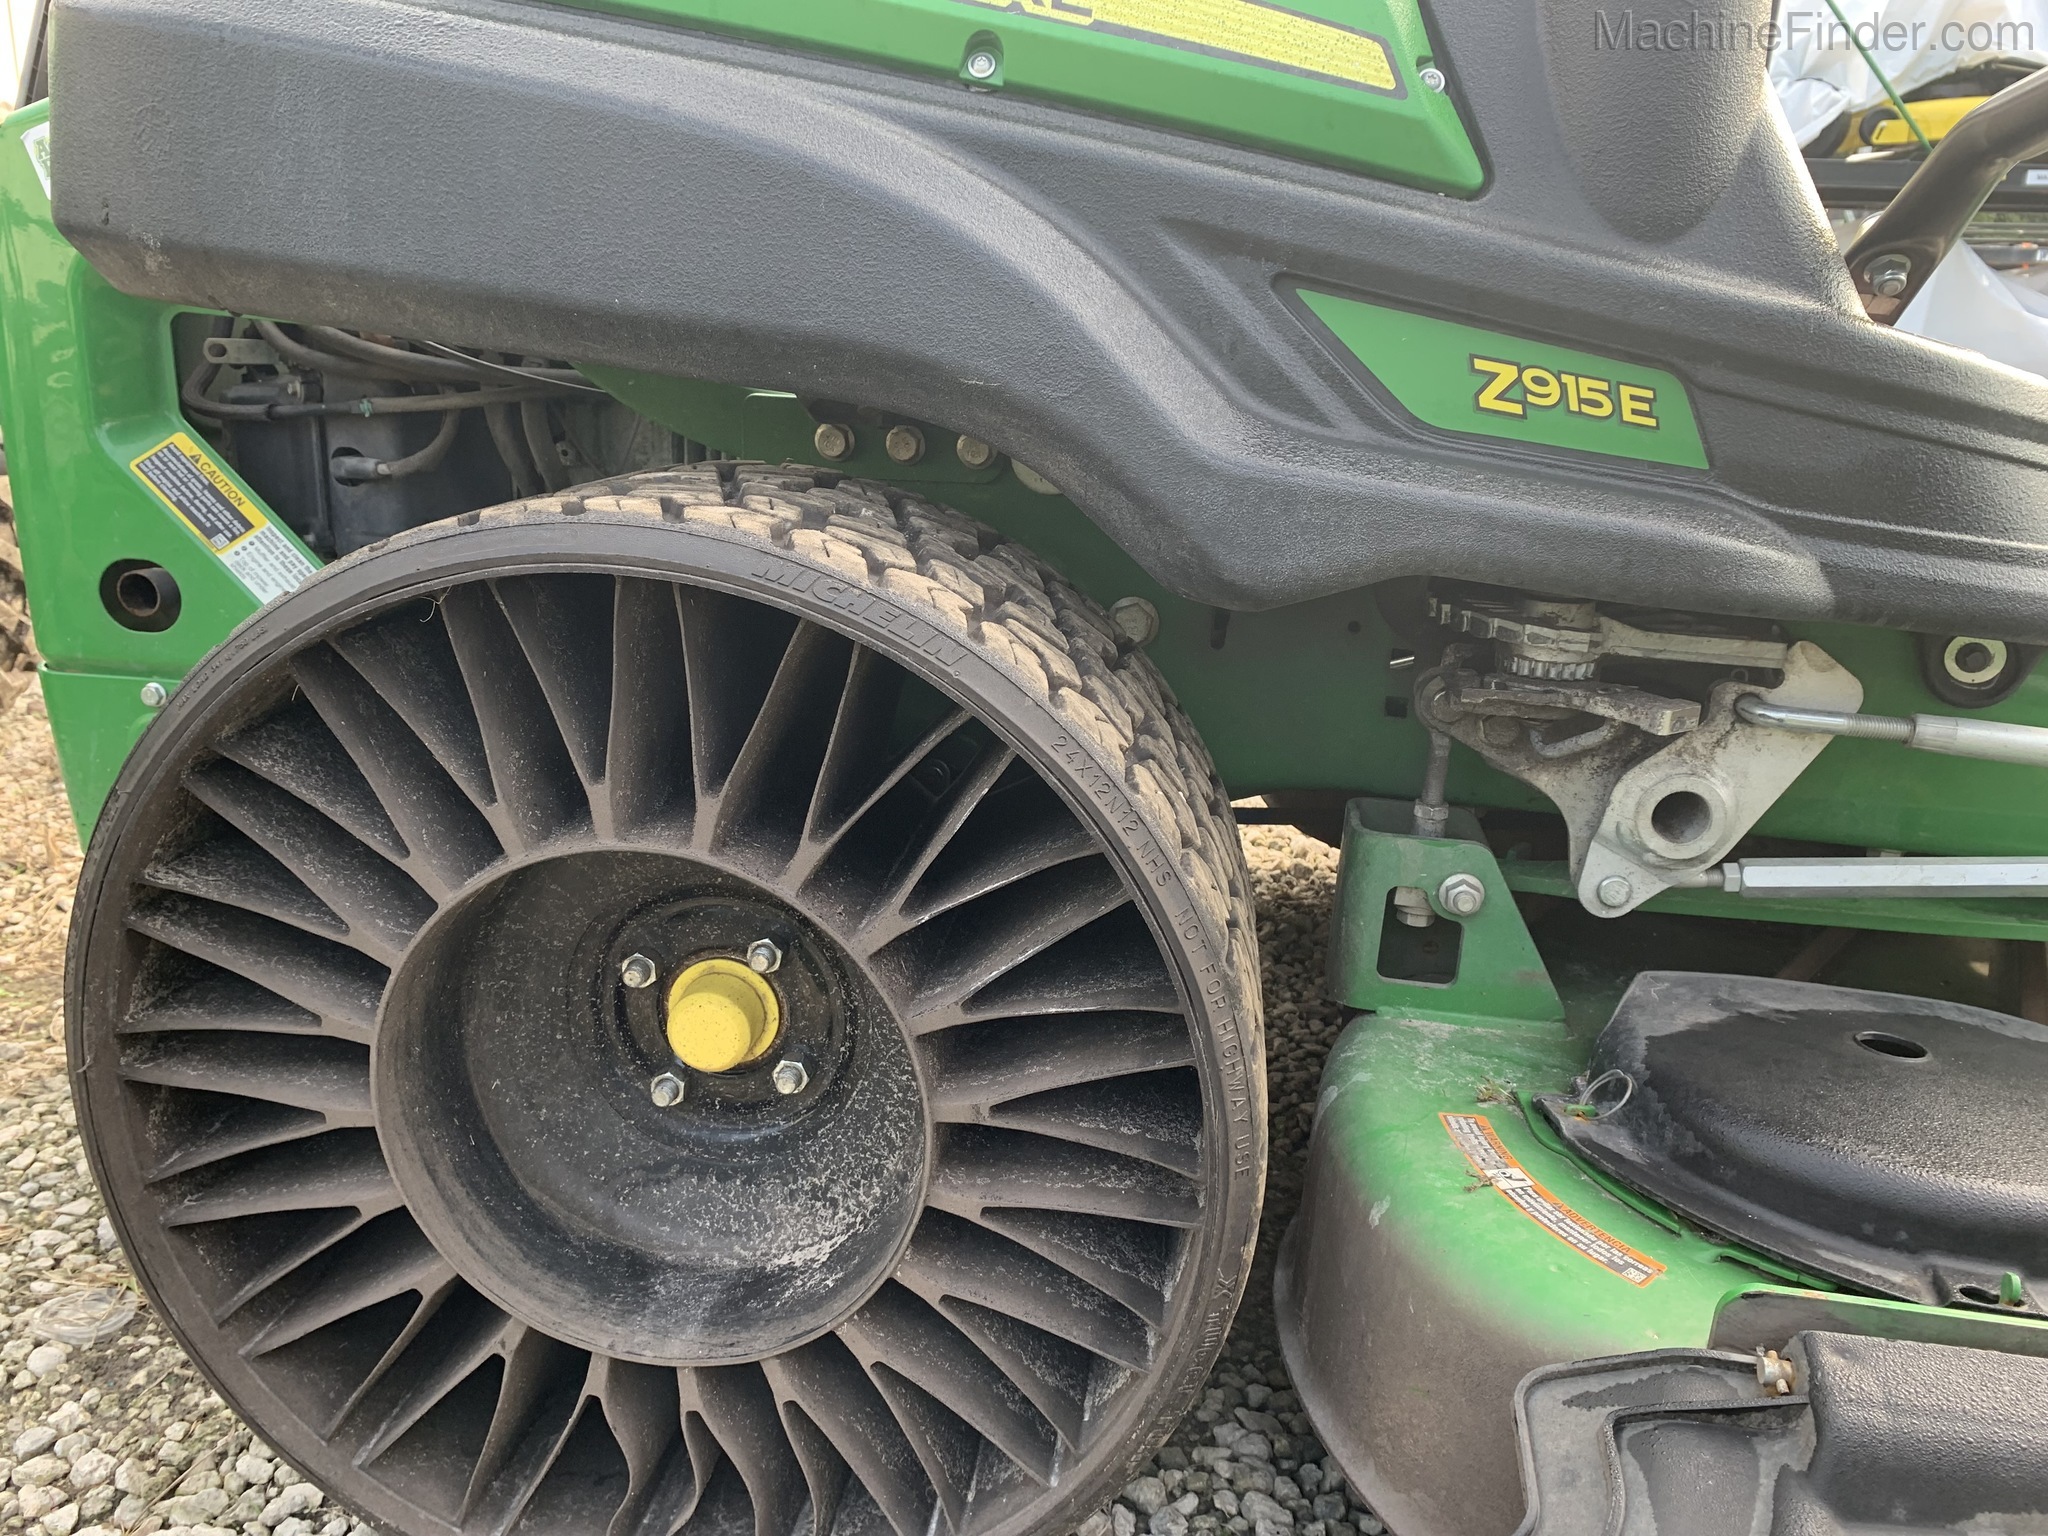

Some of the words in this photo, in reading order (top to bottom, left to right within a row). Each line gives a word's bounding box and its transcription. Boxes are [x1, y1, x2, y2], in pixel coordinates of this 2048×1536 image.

[1470, 354, 1660, 429] Z915E
[200, 462, 246, 507] CAUTION
[751, 555, 968, 667] MICHELIN
[1136, 840, 1172, 888] NHS
[1174, 906, 1208, 954] NOT
[1199, 962, 1227, 1012] FOR
[1216, 1017, 1249, 1123] HIGHWAY
[1234, 1134, 1250, 1182] USE
[1563, 1207, 1631, 1253] ADVERTENCIA
